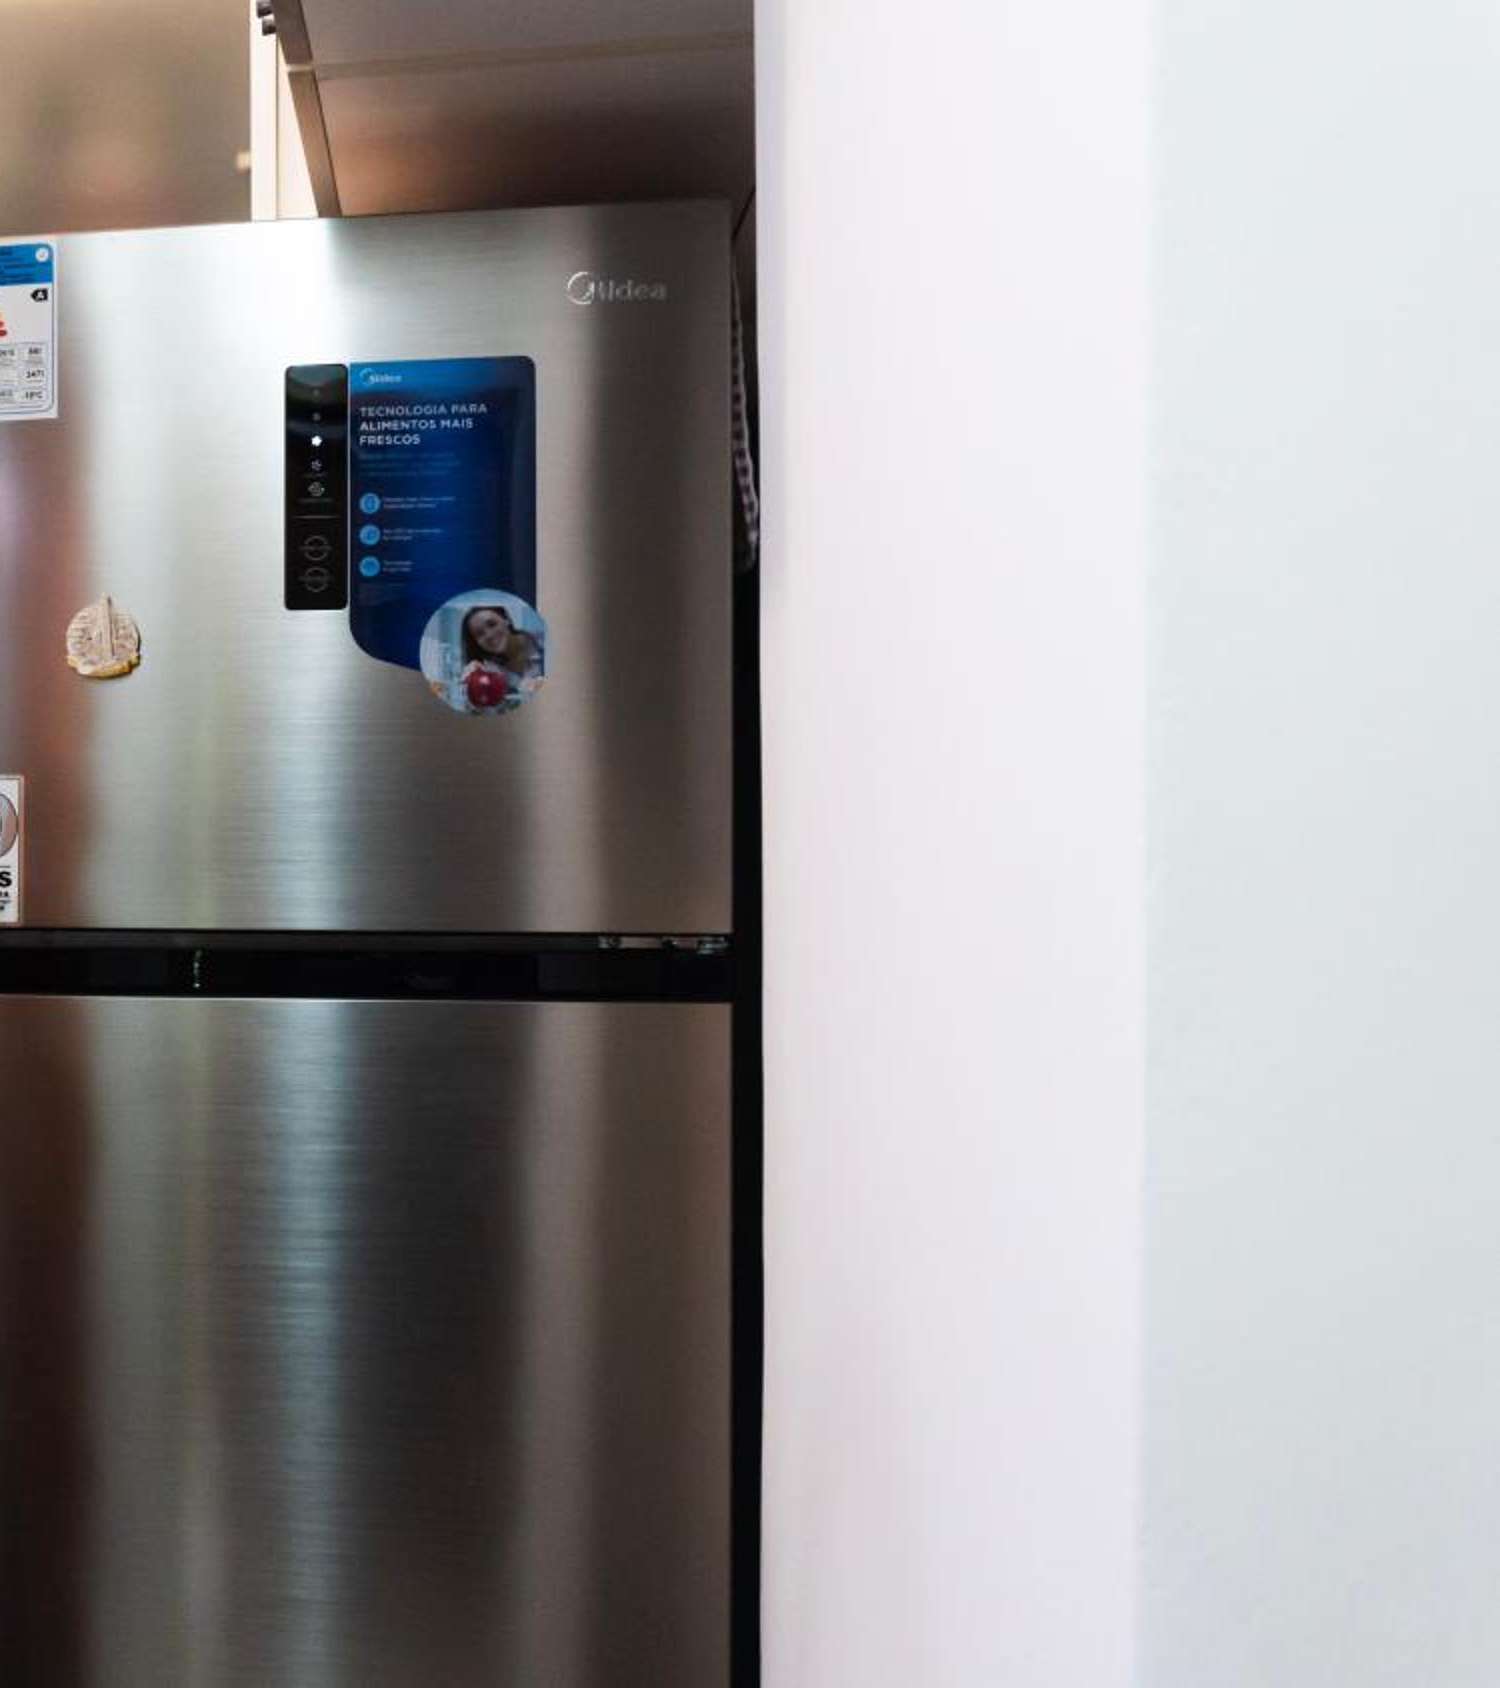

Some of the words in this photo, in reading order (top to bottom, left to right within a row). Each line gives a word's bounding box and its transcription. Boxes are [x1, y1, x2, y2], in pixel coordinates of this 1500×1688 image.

[359, 404, 448, 417] TECNOLOGIA
[451, 403, 488, 414] PARA
[359, 419, 437, 431] ALIMENTOS
[440, 418, 474, 429] MAIS
[359, 433, 421, 446] FRESCOS
